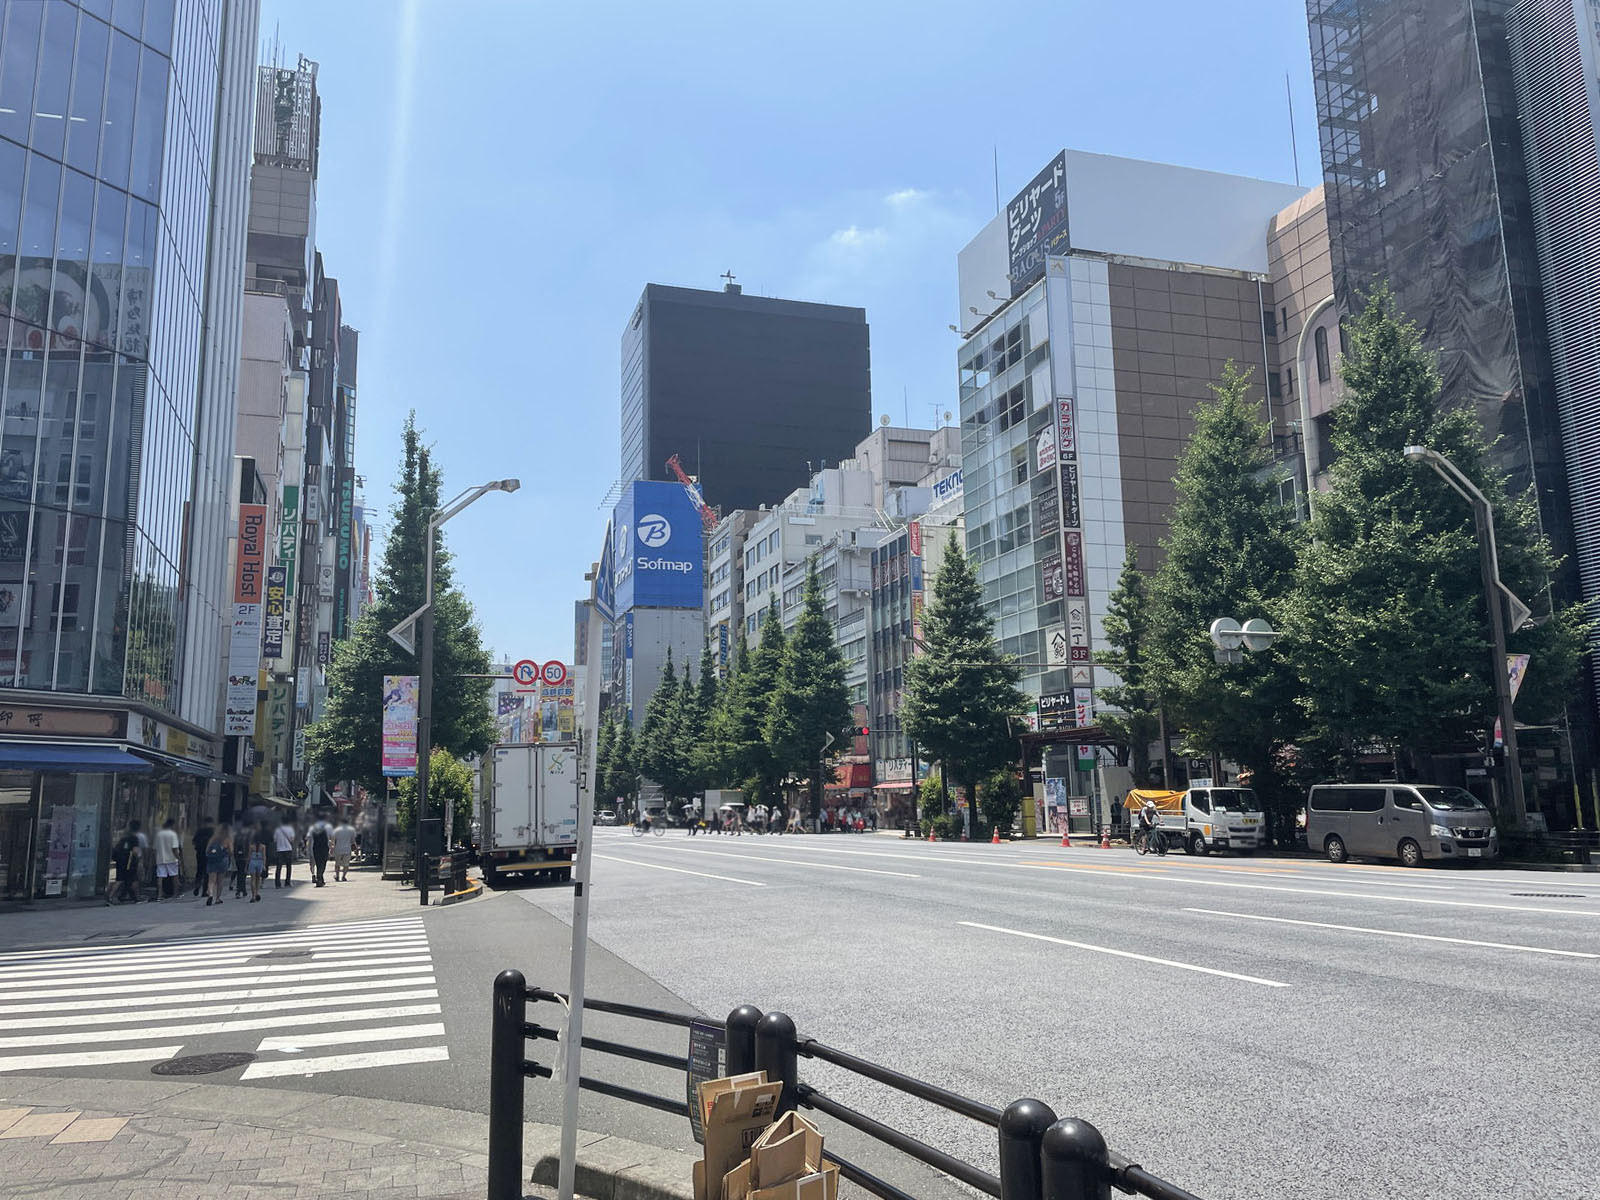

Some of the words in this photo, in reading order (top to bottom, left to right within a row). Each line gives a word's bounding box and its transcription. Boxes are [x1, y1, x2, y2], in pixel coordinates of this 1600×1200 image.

[1009, 160, 1064, 229] ビリヤード
[1010, 207, 1042, 252] ダーツ
[1060, 402, 1073, 448] カラオケ
[241, 514, 263, 556] Royal
[338, 480, 352, 571] TSUKUMO
[280, 508, 298, 595] リバティー
[637, 557, 693, 574] Sofmap
[241, 562, 260, 597] Host
[238, 605, 256, 615] 2F
[265, 586, 284, 645] 安心査定
[546, 667, 561, 679] 50
[1072, 650, 1087, 659] 3F
[272, 688, 286, 756] リバティー
